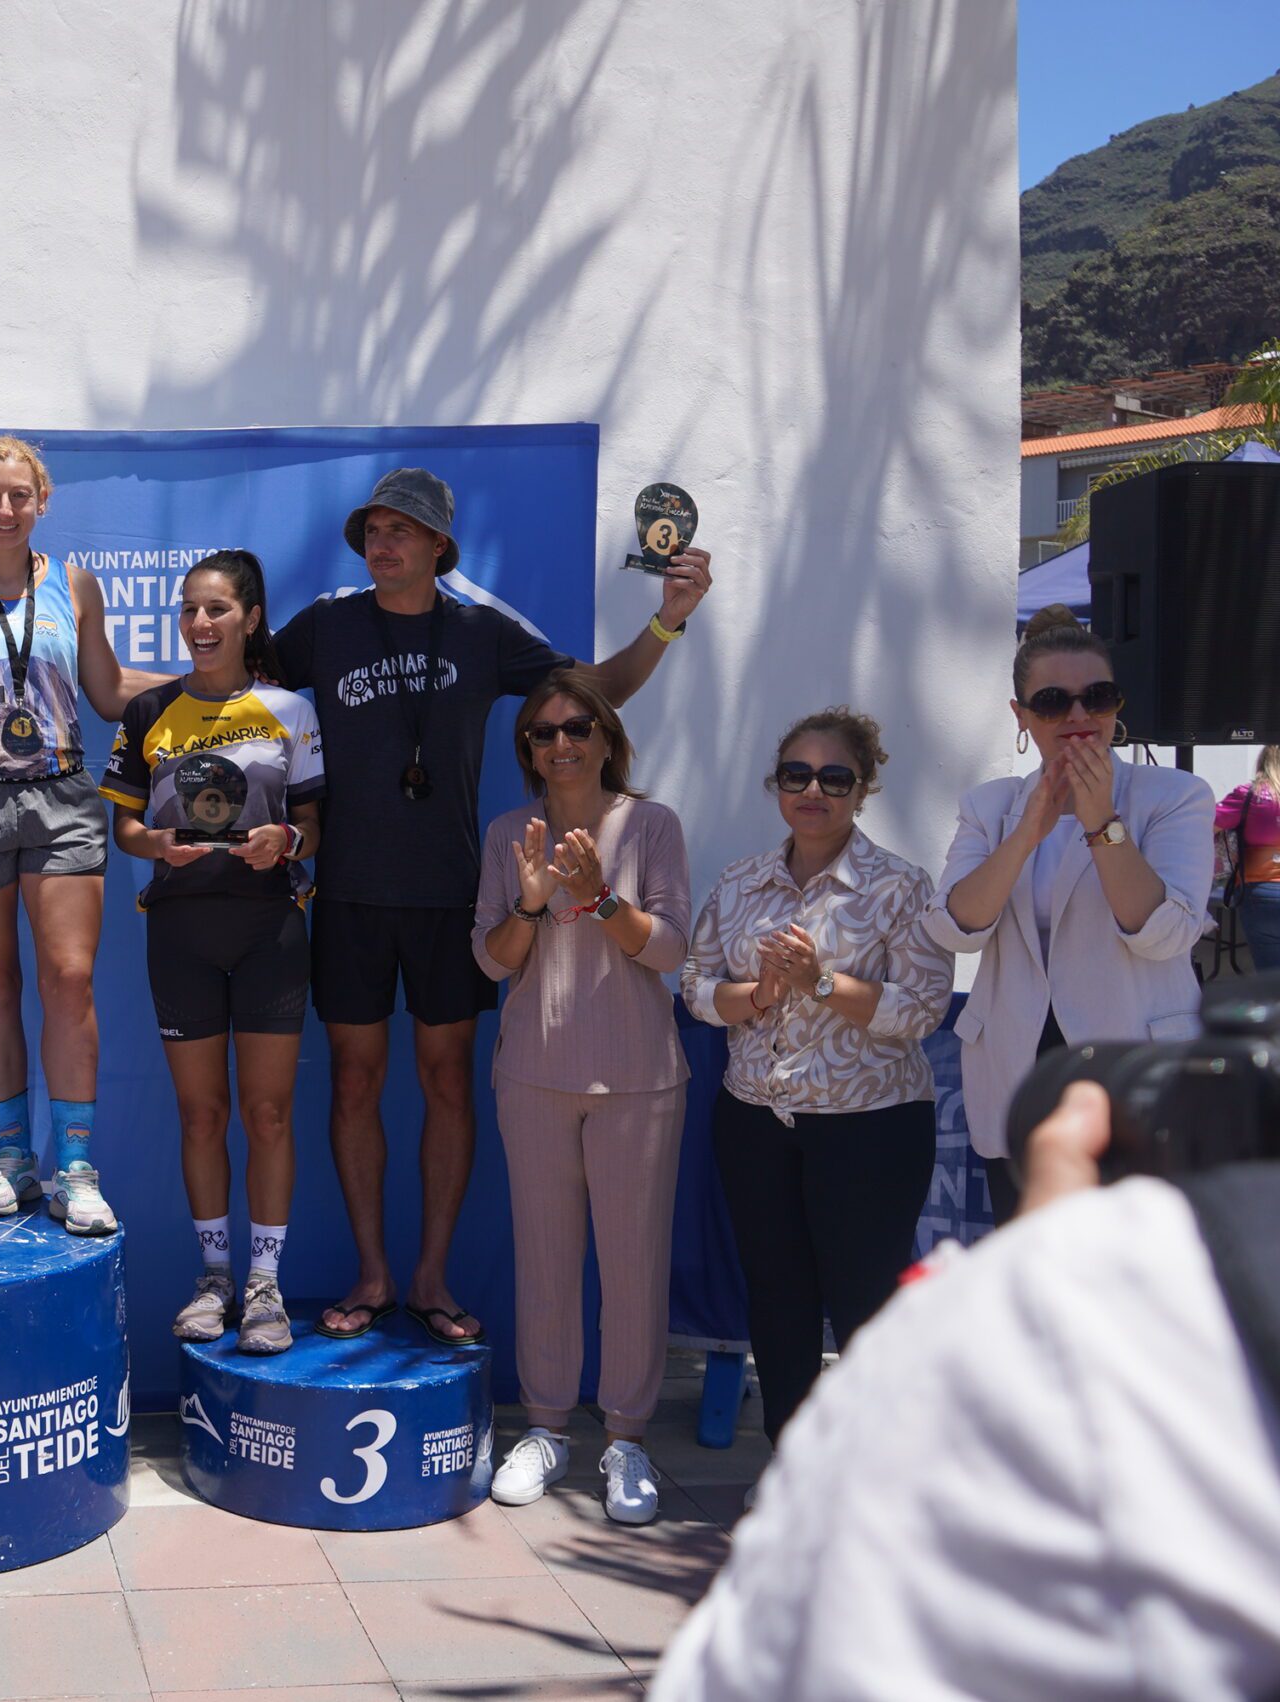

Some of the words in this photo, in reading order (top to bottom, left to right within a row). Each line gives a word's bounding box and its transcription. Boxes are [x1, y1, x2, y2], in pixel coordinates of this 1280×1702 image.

[656, 524, 672, 549] 3
[104, 614, 192, 662] TEI
[371, 653, 429, 677] CANAR
[13, 1420, 99, 1479] TEIDE
[230, 1421, 295, 1449] SANTIAGO
[423, 1433, 473, 1456] SANTIAGO
[229, 1436, 238, 1455] DEL
[238, 1438, 295, 1470] TEIDE
[320, 1409, 397, 1504] 3
[422, 1457, 430, 1477] DEL
[432, 1447, 473, 1475] TEIDE
